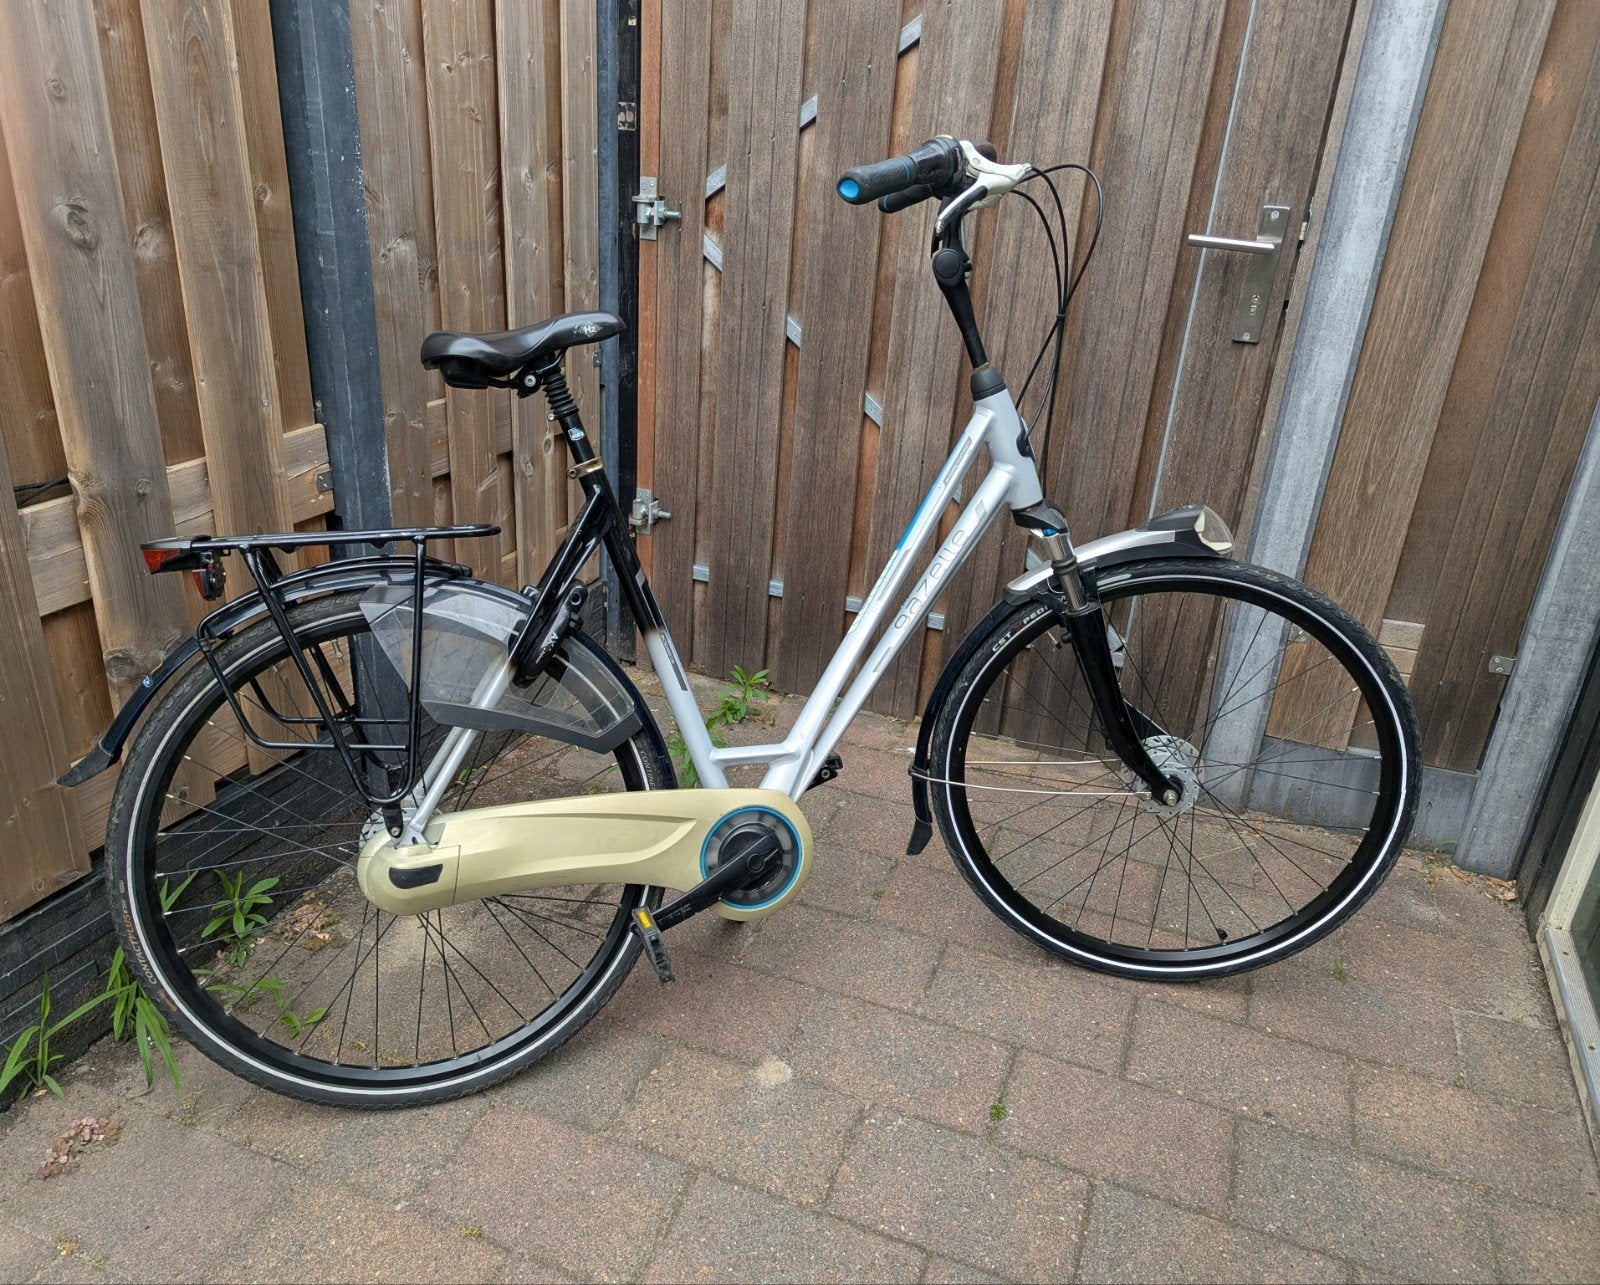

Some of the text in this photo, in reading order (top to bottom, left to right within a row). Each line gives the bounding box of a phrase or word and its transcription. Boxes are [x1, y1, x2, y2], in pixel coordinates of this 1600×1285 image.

[894, 529, 966, 630] gazelle
[992, 630, 1011, 652] CST
[640, 750, 656, 789] CONTINE
